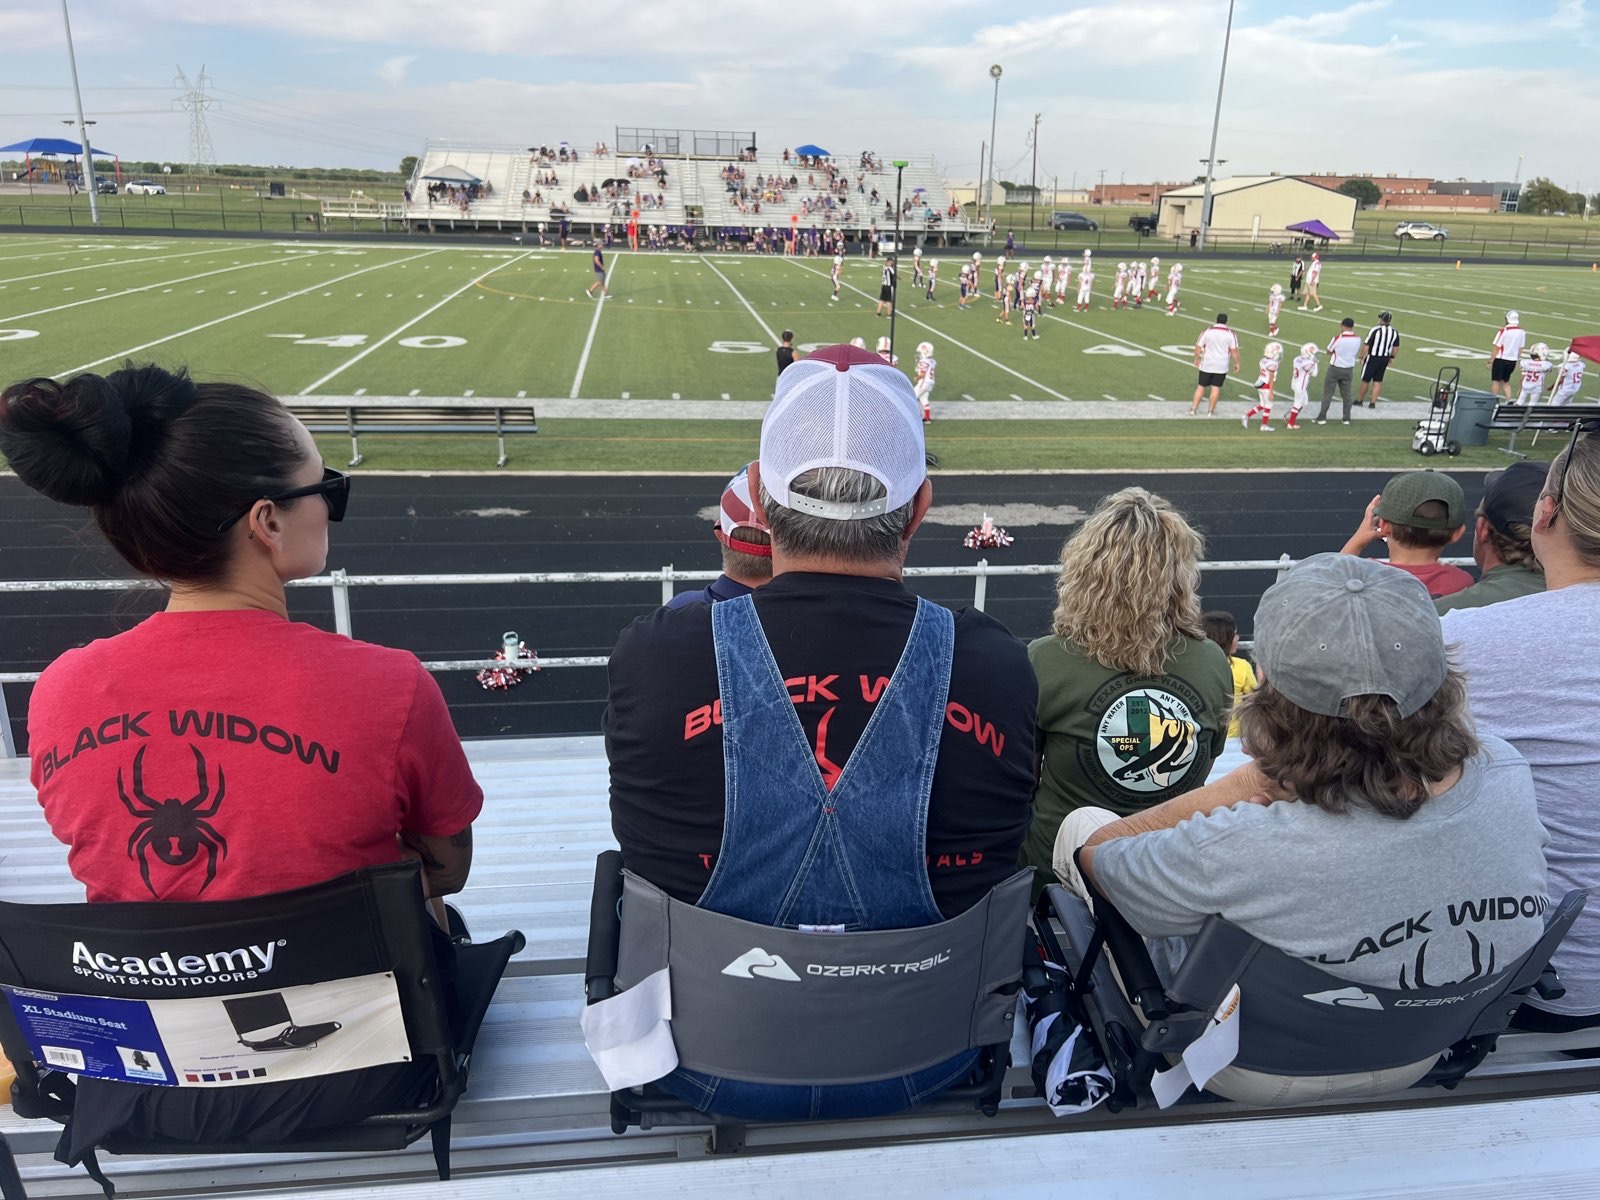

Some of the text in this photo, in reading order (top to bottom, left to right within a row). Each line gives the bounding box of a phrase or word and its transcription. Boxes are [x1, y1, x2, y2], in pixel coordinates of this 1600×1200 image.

[1525, 370, 1541, 383] 55
[1572, 371, 1583, 384] 15
[1092, 680, 1123, 708] TEXAS
[1161, 676, 1202, 710] WARDEN
[1160, 693, 1190, 719] ANY TIME
[684, 674, 1006, 757] BLCK WOW
[1101, 700, 1125, 734] ANY WATER
[40, 709, 340, 784] BLACK WIDOW
[1301, 910, 1433, 965] LACK
[72, 941, 276, 976] Academy
[806, 951, 950, 977] OZARK TRAIL
[73, 965, 259, 987] SPORTS+OUTDOORS
[22, 1004, 42, 1015] XL
[42, 1007, 97, 1025] Stadium
[98, 1016, 129, 1031] Seat
